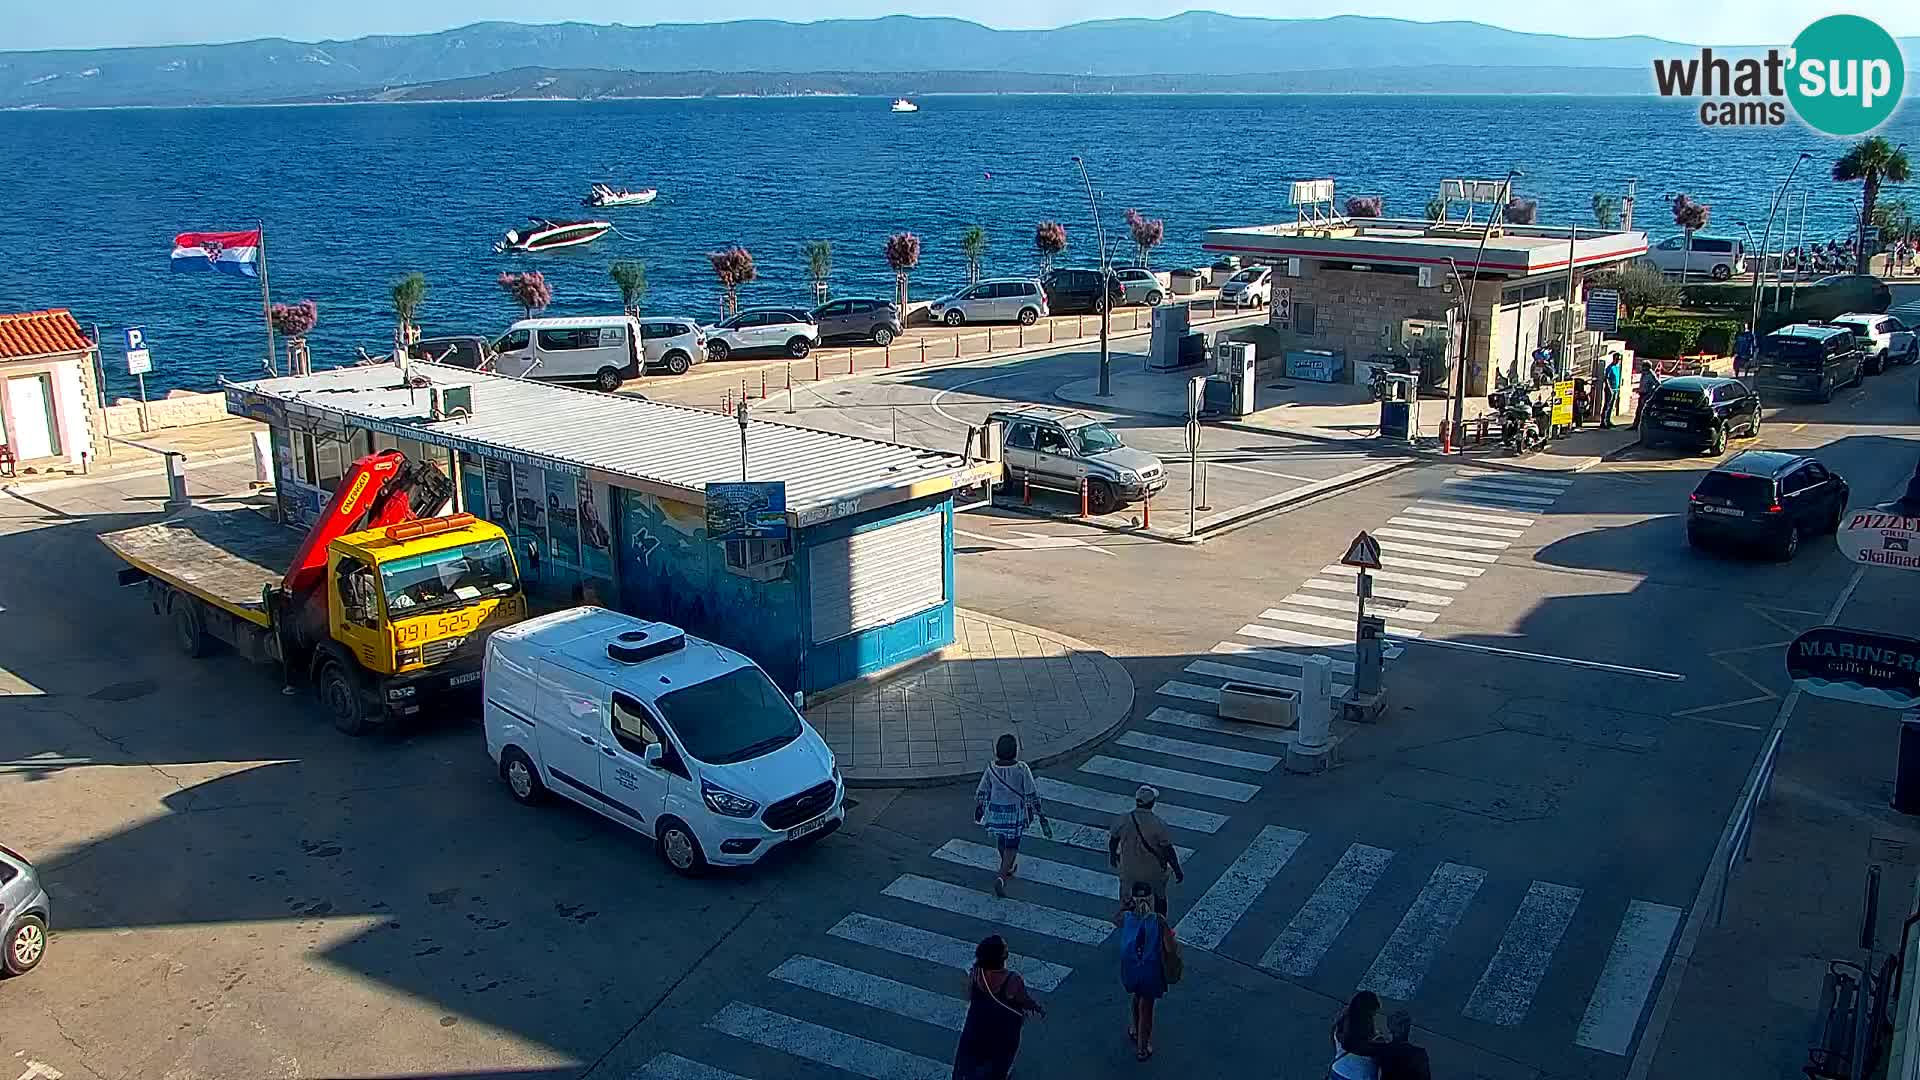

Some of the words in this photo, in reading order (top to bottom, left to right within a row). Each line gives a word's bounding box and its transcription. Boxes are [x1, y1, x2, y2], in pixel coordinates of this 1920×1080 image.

[436, 437, 467, 451] POSTAJA
[494, 449, 525, 464] STATION
[527, 457, 553, 470] TICKET
[555, 464, 581, 476] OFFICE
[396, 623, 428, 643] 091
[438, 612, 470, 635] 525
[1869, 664, 1896, 680] bar
